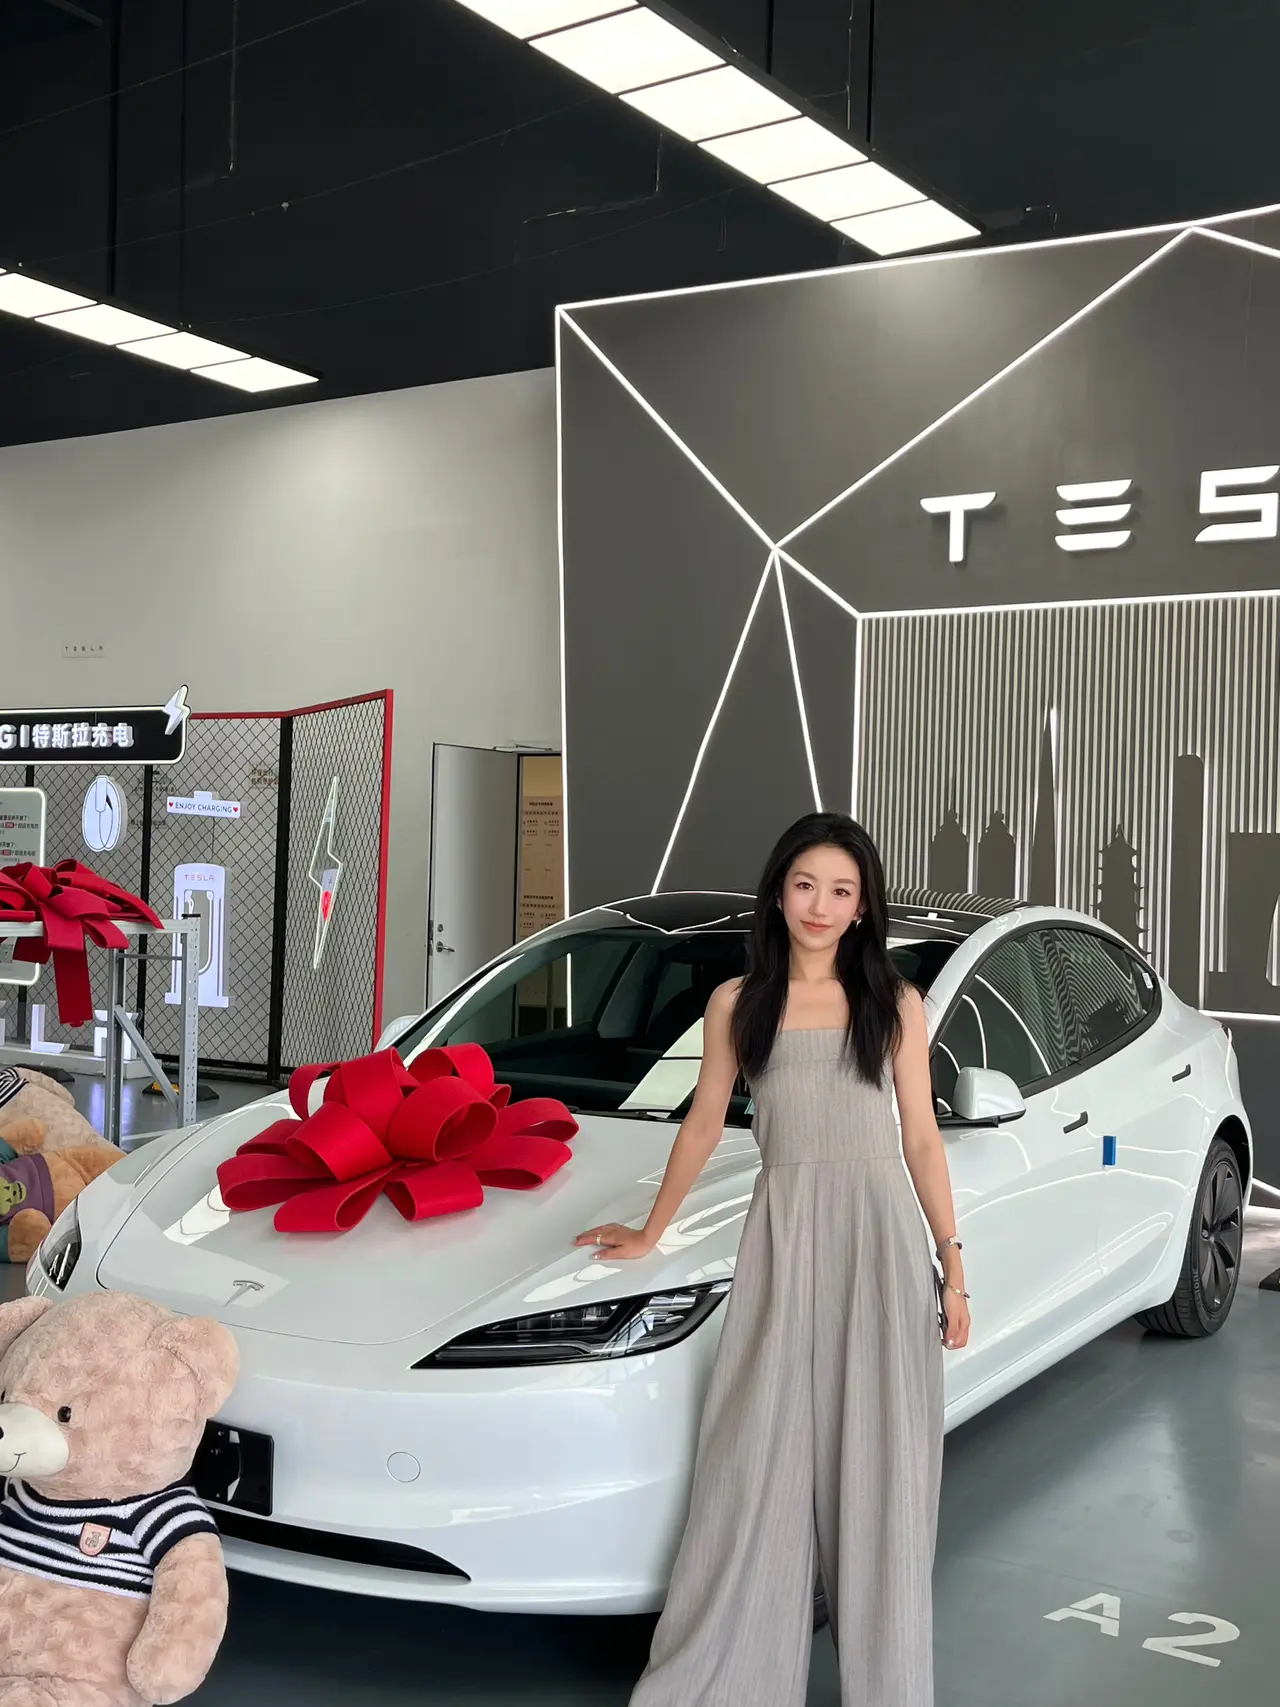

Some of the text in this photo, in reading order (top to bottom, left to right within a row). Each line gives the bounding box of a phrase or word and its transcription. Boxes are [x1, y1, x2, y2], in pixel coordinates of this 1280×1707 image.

[32, 722, 134, 748] 特斯拉充电
[175, 801, 232, 813] ENJOY CHARGING
[184, 874, 215, 882] TESLA
[1042, 1592, 1241, 1668] A2
